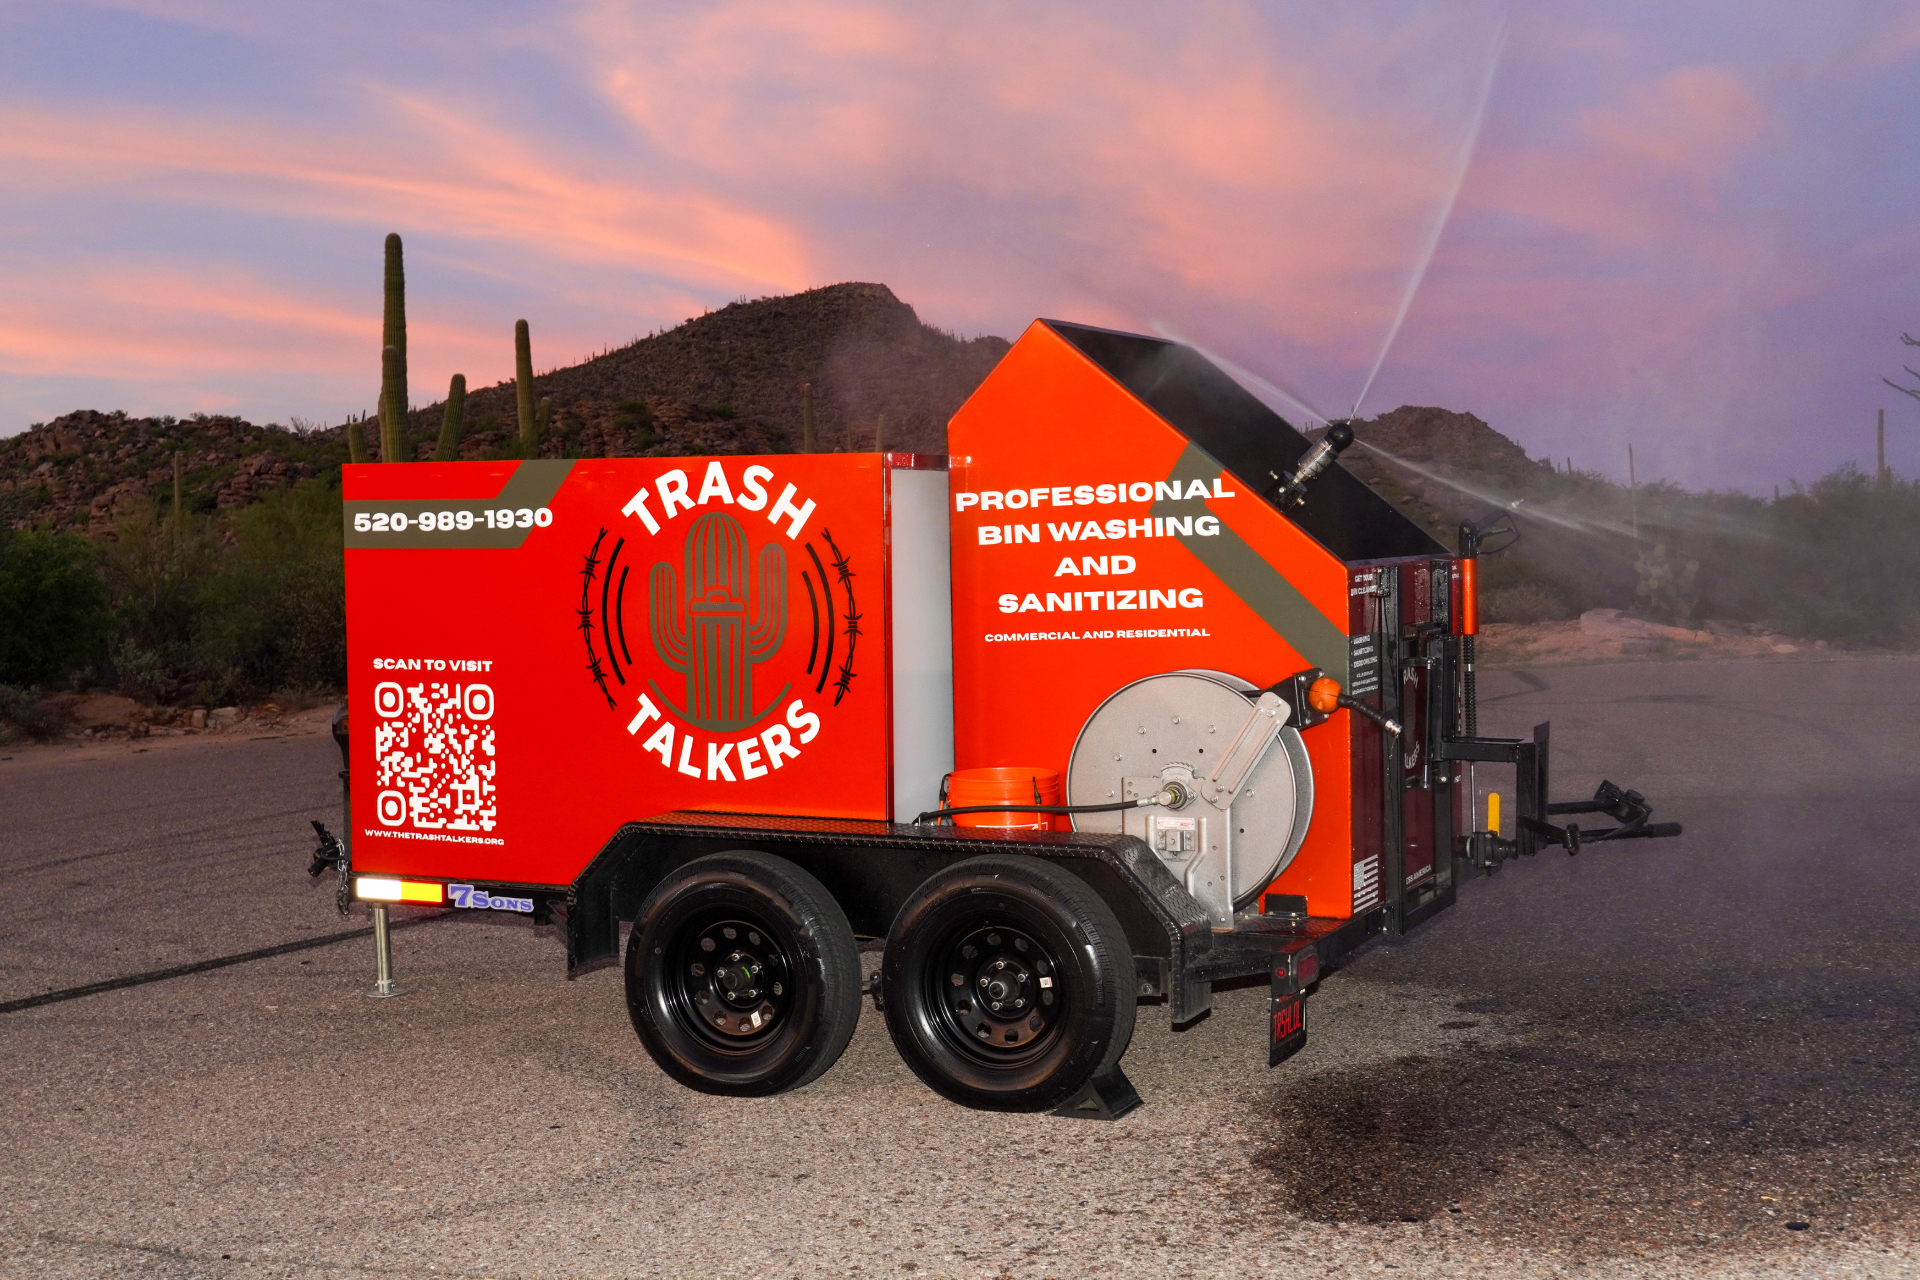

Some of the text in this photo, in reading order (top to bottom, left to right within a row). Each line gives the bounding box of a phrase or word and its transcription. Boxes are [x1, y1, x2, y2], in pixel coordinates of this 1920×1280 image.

[621, 461, 817, 540] TRASH
[956, 478, 1236, 512] PROFESSIONAL
[354, 507, 553, 532] 520-989-1930
[978, 516, 1220, 545] BIN WASHING
[1054, 555, 1136, 577] AND
[998, 588, 1204, 614] SANITIZING
[985, 628, 1211, 642] COMMERCIAL AND RESIDENTIAL
[373, 658, 493, 672] SCAN TO VISIT
[1402, 666, 1419, 689] RASH
[626, 692, 820, 782] TALKERS
[365, 829, 504, 845] WWW.THETRASHTALKERS.ORG
